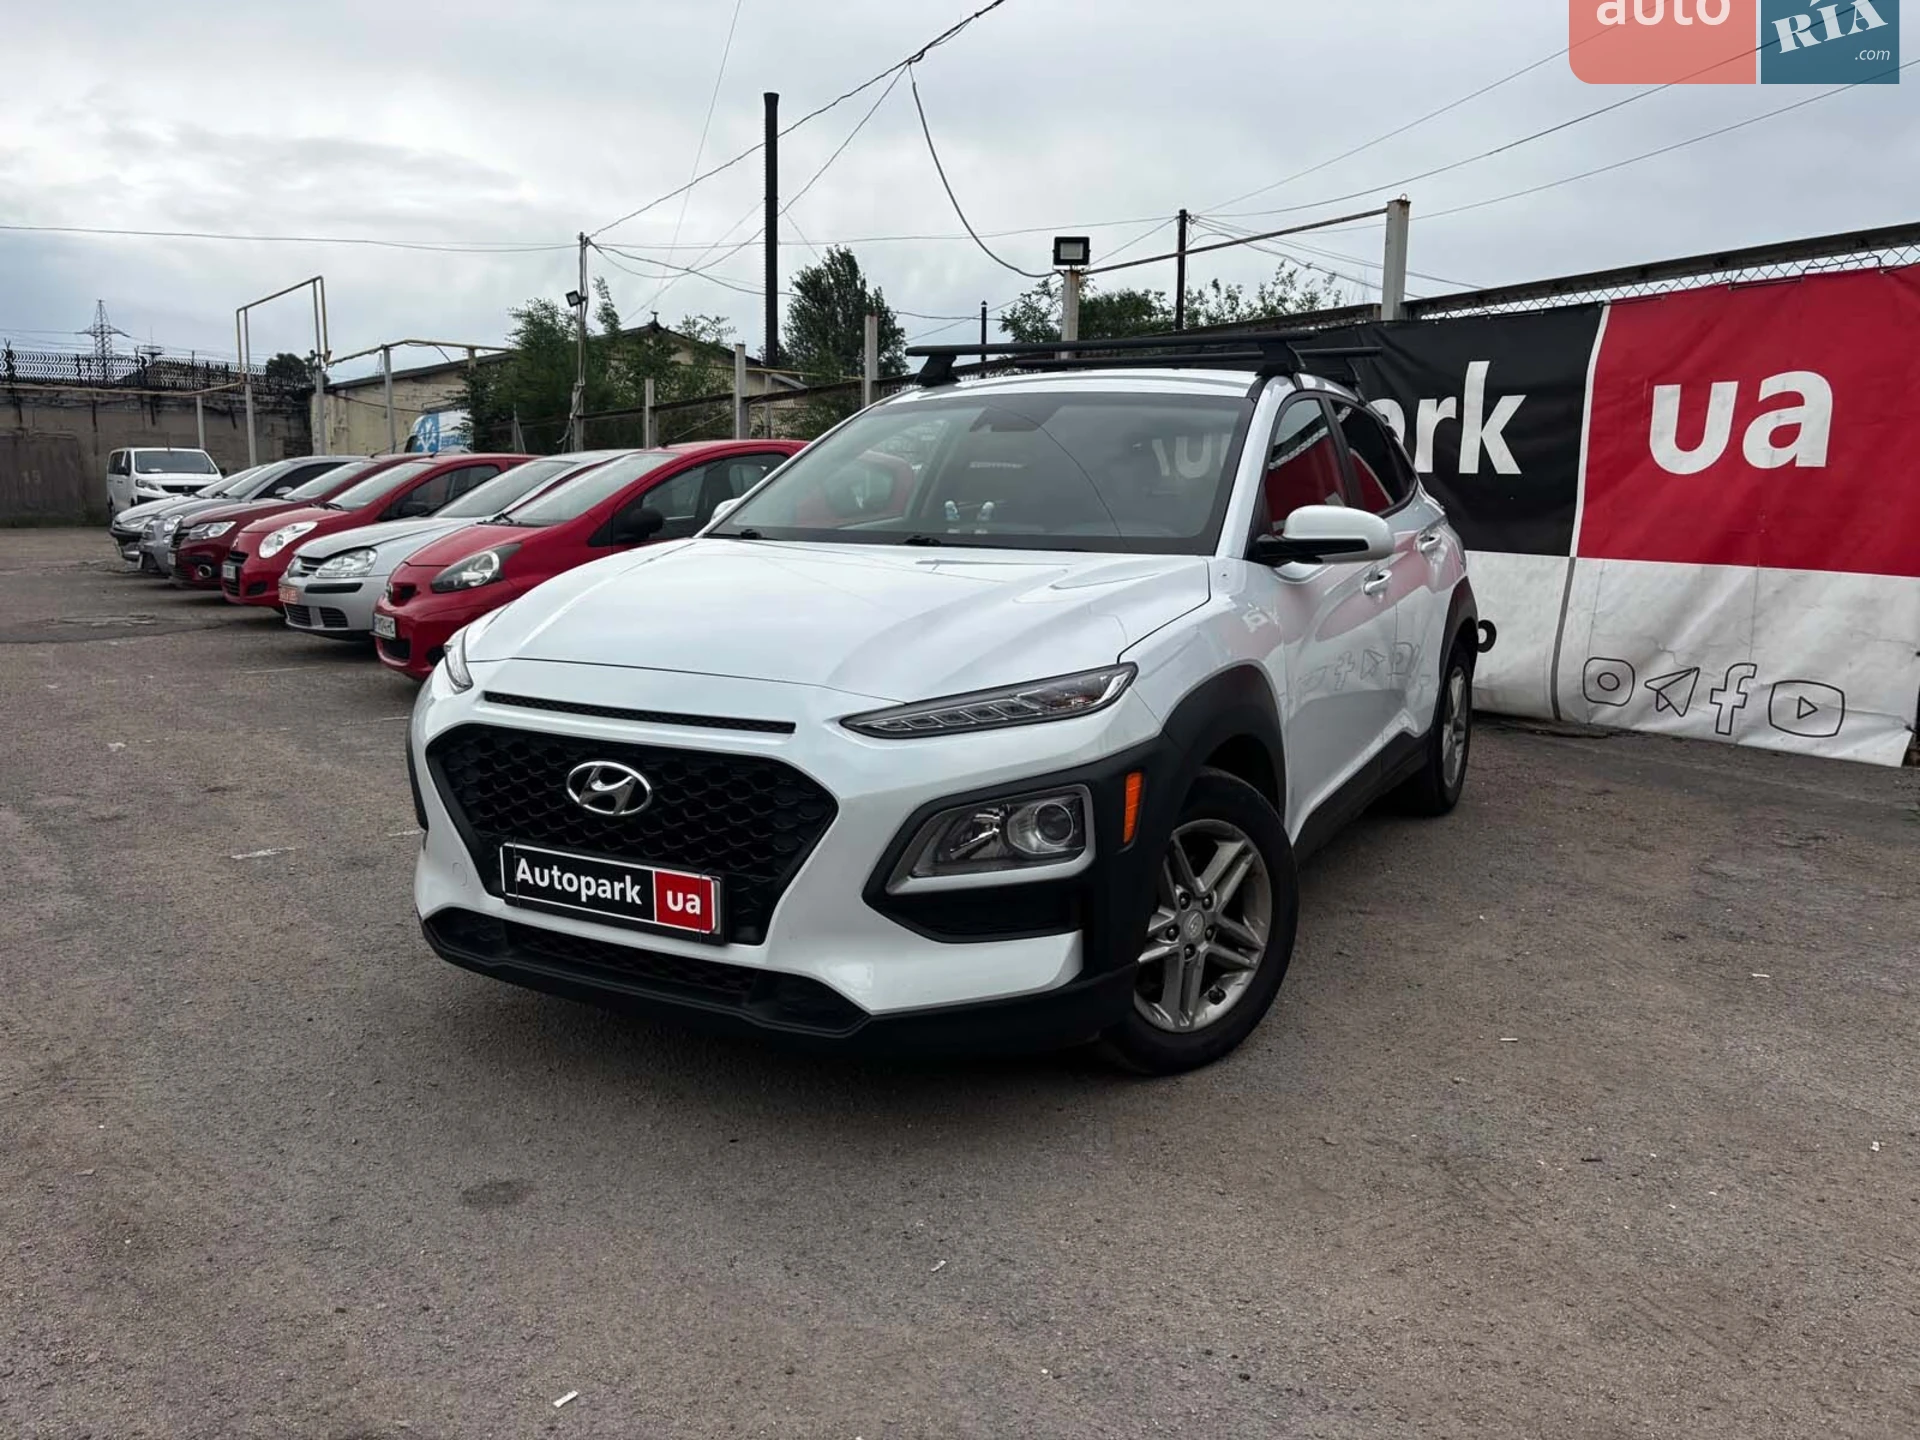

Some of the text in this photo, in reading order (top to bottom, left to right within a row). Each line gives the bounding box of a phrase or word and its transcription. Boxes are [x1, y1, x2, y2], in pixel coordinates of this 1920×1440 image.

[1649, 371, 1833, 475] ua
[516, 858, 701, 915] Autopark ua
